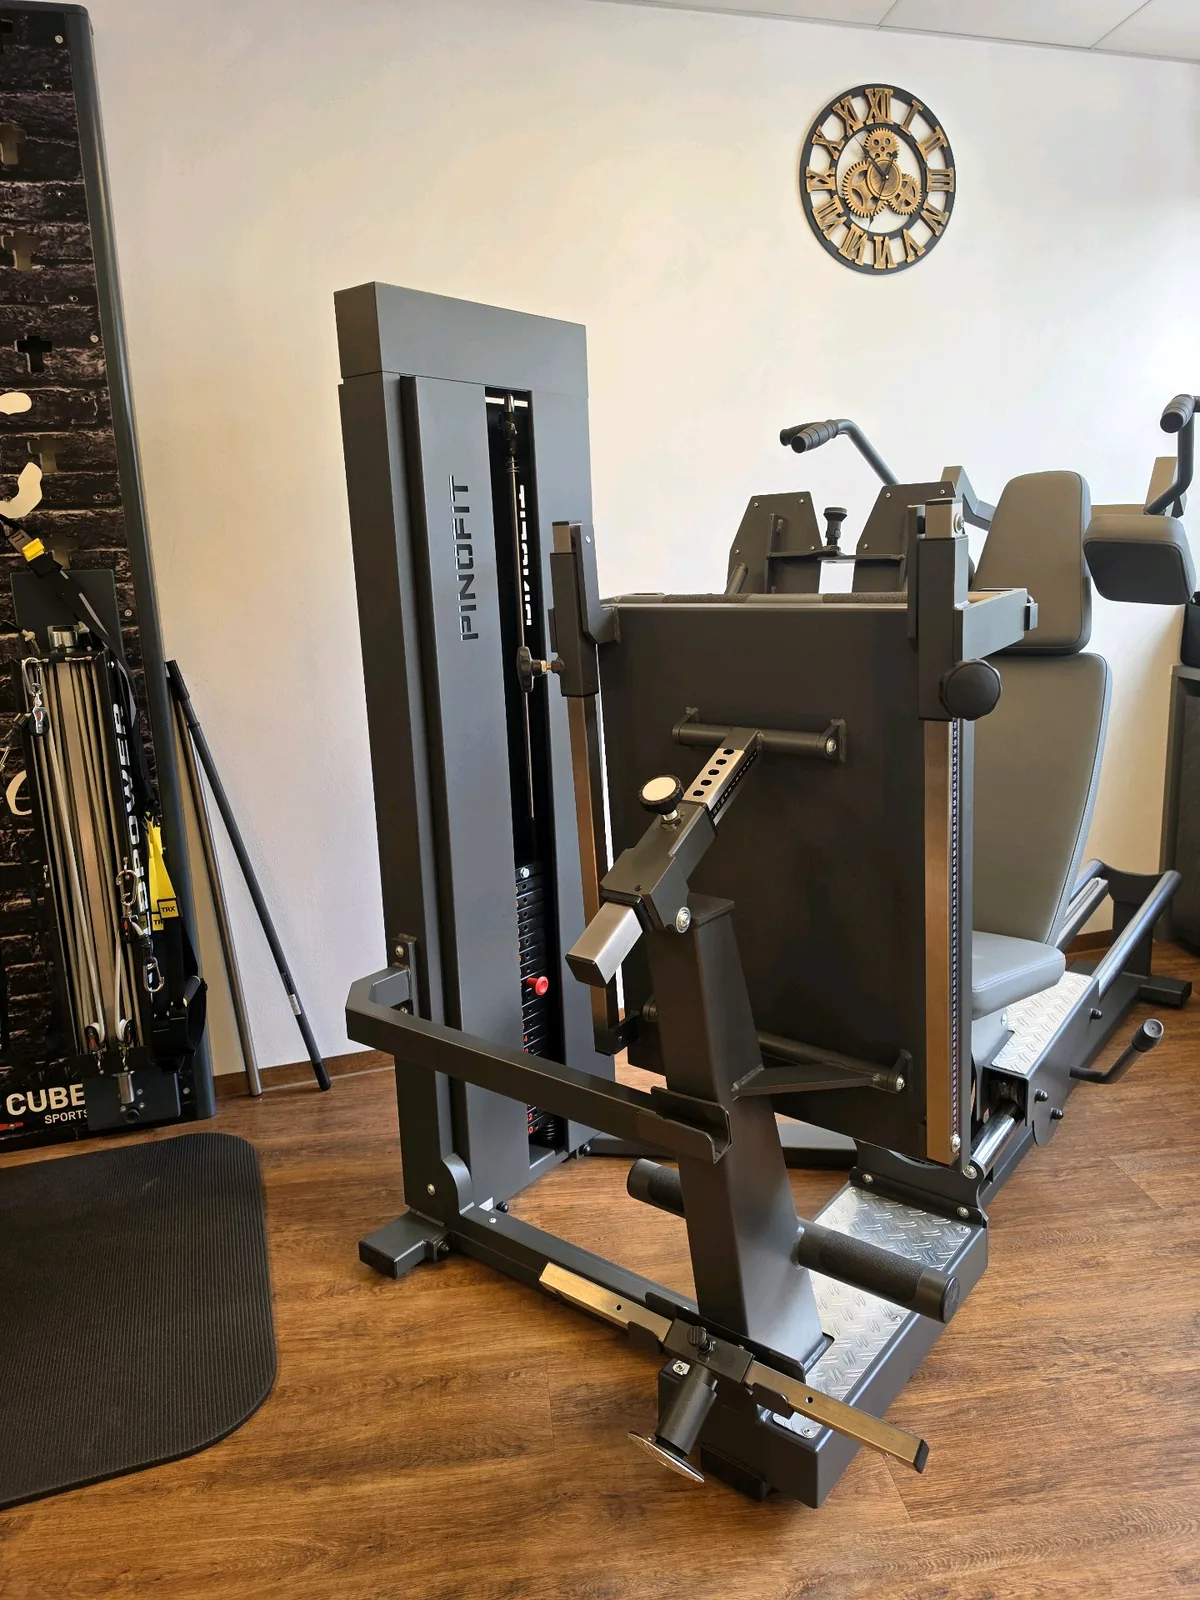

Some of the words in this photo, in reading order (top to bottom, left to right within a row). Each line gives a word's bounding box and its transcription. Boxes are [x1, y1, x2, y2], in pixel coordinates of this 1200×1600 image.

[449, 475, 479, 641] PINOFIT
[6, 1083, 86, 1116] CUBE
[44, 1109, 88, 1124] SPORTS
